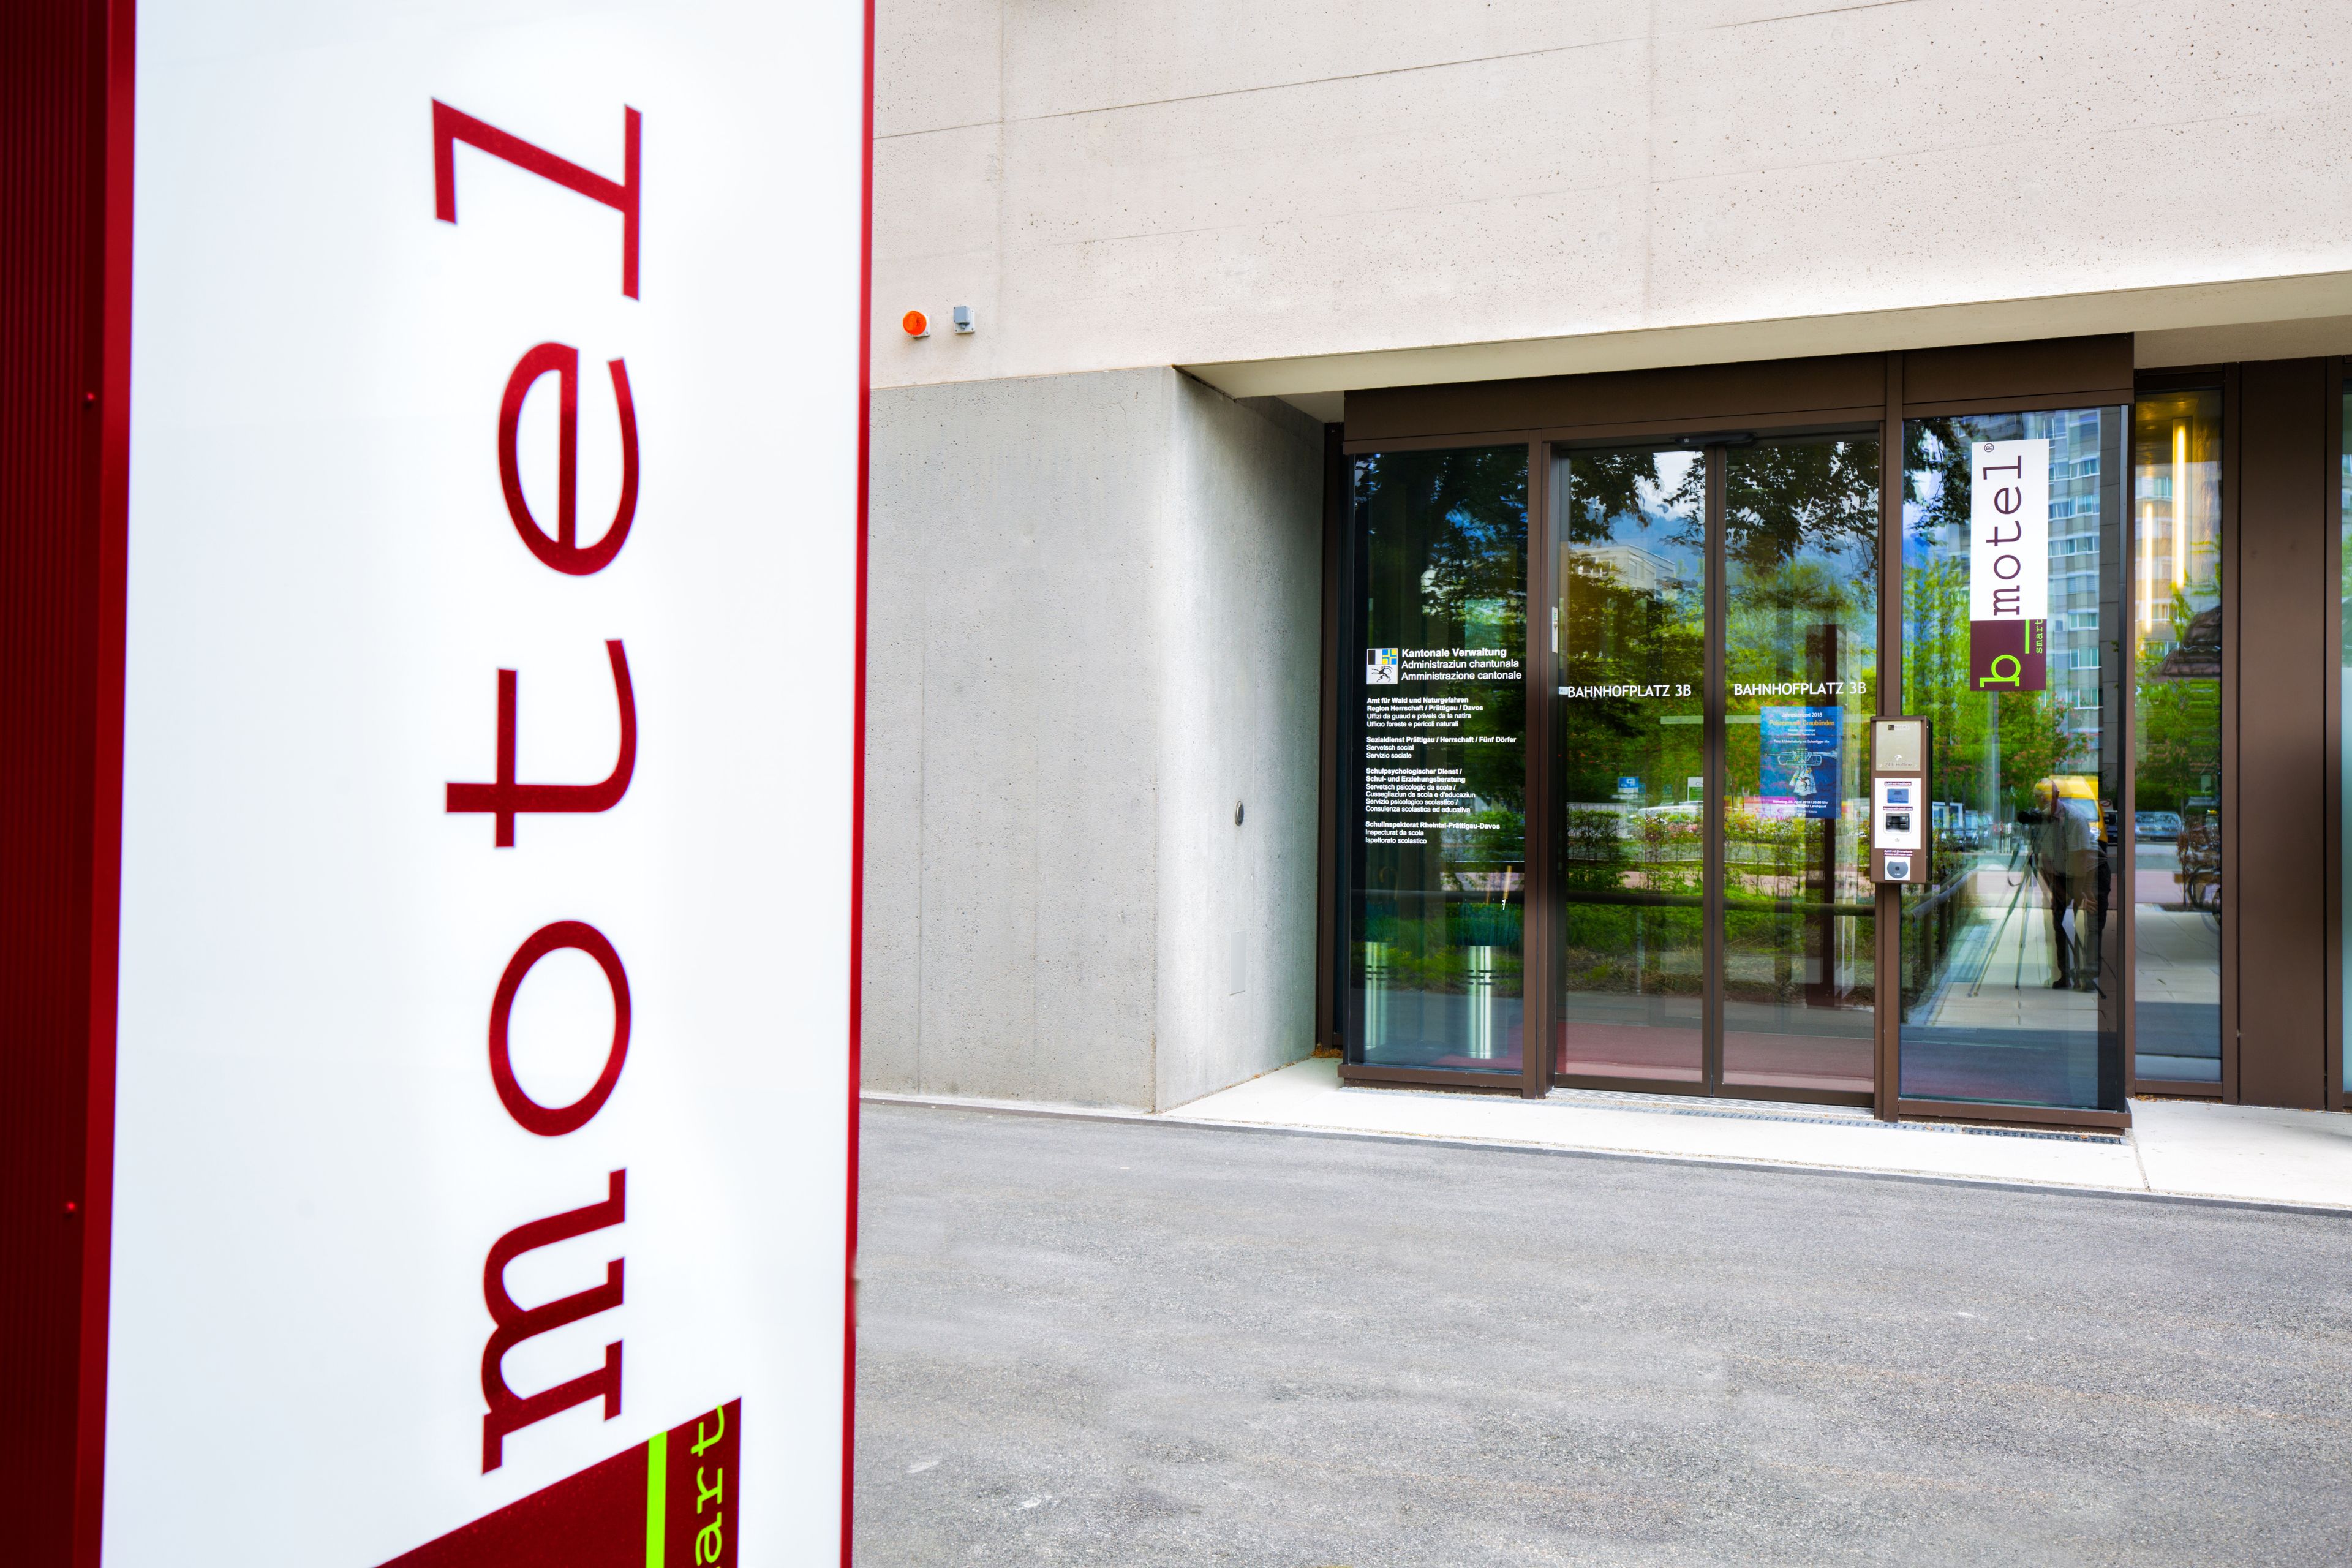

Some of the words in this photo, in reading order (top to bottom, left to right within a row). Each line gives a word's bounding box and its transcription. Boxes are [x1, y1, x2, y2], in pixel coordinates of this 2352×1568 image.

[1983, 456, 2021, 616] motel
[1401, 649, 1449, 657] Kantonale
[1452, 648, 1507, 658] Verwaltung
[1401, 660, 1467, 669] Administraziun
[1469, 659, 1519, 668] chantunala
[1401, 671, 1475, 680] Amministrazione
[1477, 670, 1522, 679] cantonale
[1567, 685, 1670, 698] BAHNHOFPLATZ
[1675, 684, 1692, 696] 3B
[1734, 682, 1844, 696] BAHNHOFPLATZ
[1849, 682, 1867, 694] 3B
[433, 98, 643, 1475] motel
[690, 1404, 725, 1568] art
